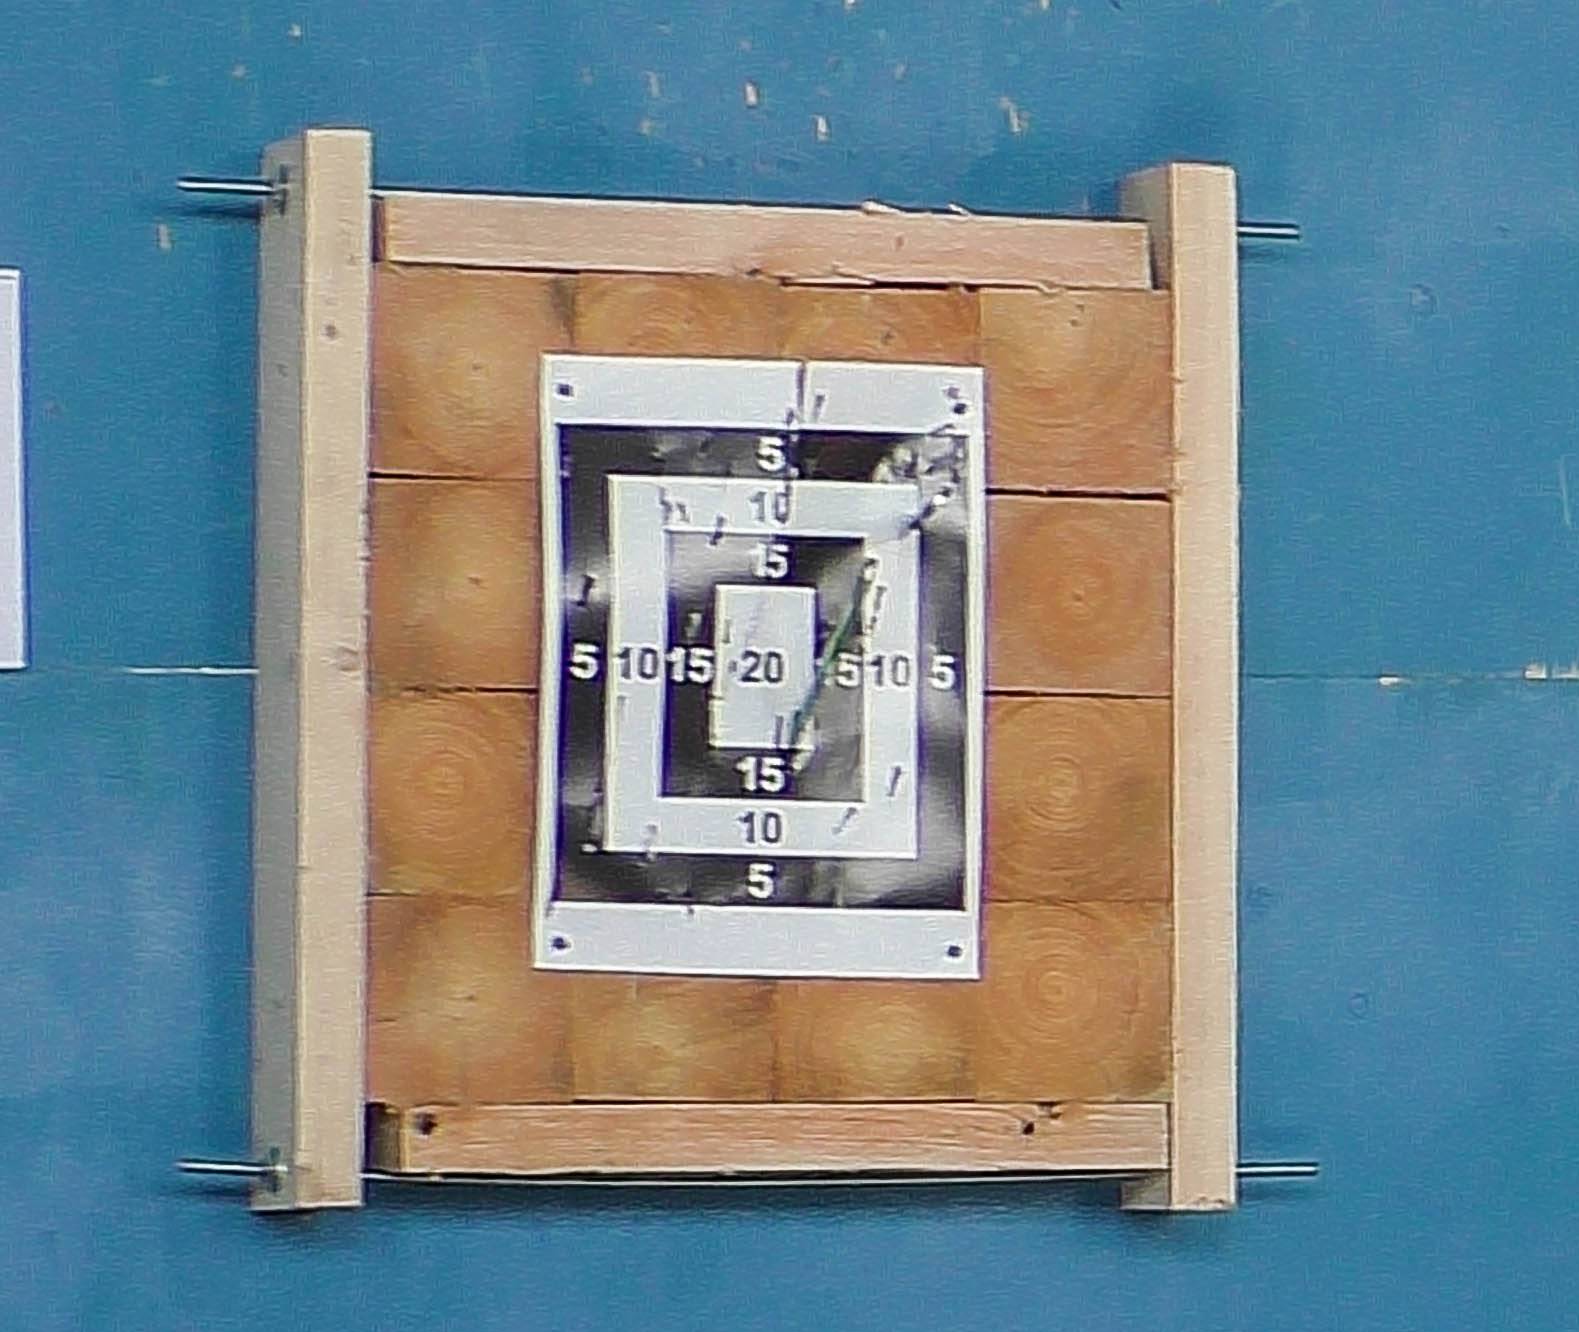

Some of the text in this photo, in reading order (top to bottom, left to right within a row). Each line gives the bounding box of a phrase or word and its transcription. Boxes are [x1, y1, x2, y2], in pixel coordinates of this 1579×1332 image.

[756, 436, 786, 472] 5
[750, 488, 790, 524] 10
[570, 645, 599, 680] 5
[619, 649, 658, 681] 10
[665, 648, 714, 683] 15
[740, 652, 783, 682] 20
[866, 655, 910, 687] 10
[931, 654, 956, 690] 5
[736, 755, 785, 791] 15
[738, 813, 781, 843] 10
[748, 863, 774, 897] 5
